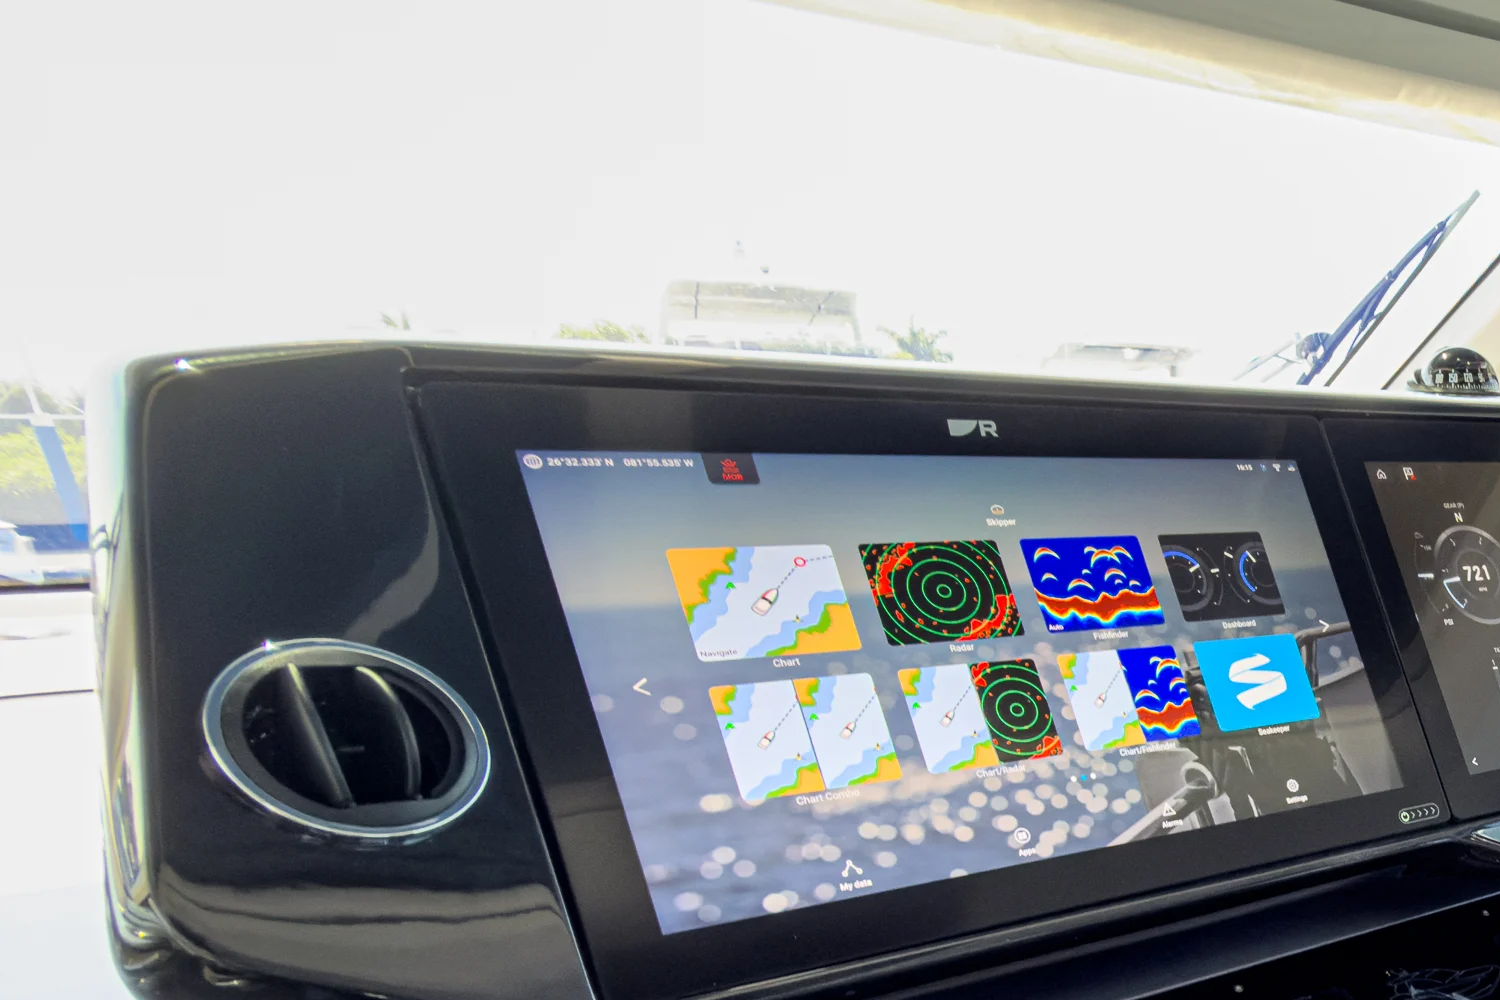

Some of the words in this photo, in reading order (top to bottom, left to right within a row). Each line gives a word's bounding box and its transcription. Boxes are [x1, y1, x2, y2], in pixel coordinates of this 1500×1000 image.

[604, 458, 615, 467] N
[684, 458, 694, 467] W
[721, 473, 744, 481] MOB
[986, 517, 1017, 528] Skipper
[1453, 512, 1464, 522] N
[1462, 564, 1491, 582] 721
[1048, 623, 1065, 632] Auto
[1222, 618, 1257, 631] Dashboard
[1093, 629, 1129, 642] Fishfinder
[699, 648, 739, 659] Navigate
[949, 642, 975, 654] Radar
[772, 656, 800, 669] Chart
[1257, 723, 1291, 737] Seakeeper
[1119, 741, 1177, 758] Chart/Fishfinder
[975, 763, 1027, 779] Chart/Radar
[795, 793, 823, 807] Chart
[824, 788, 861, 803] Combo
[1018, 846, 1037, 858] Apps
[839, 880, 852, 893] My
[853, 877, 873, 890] data
